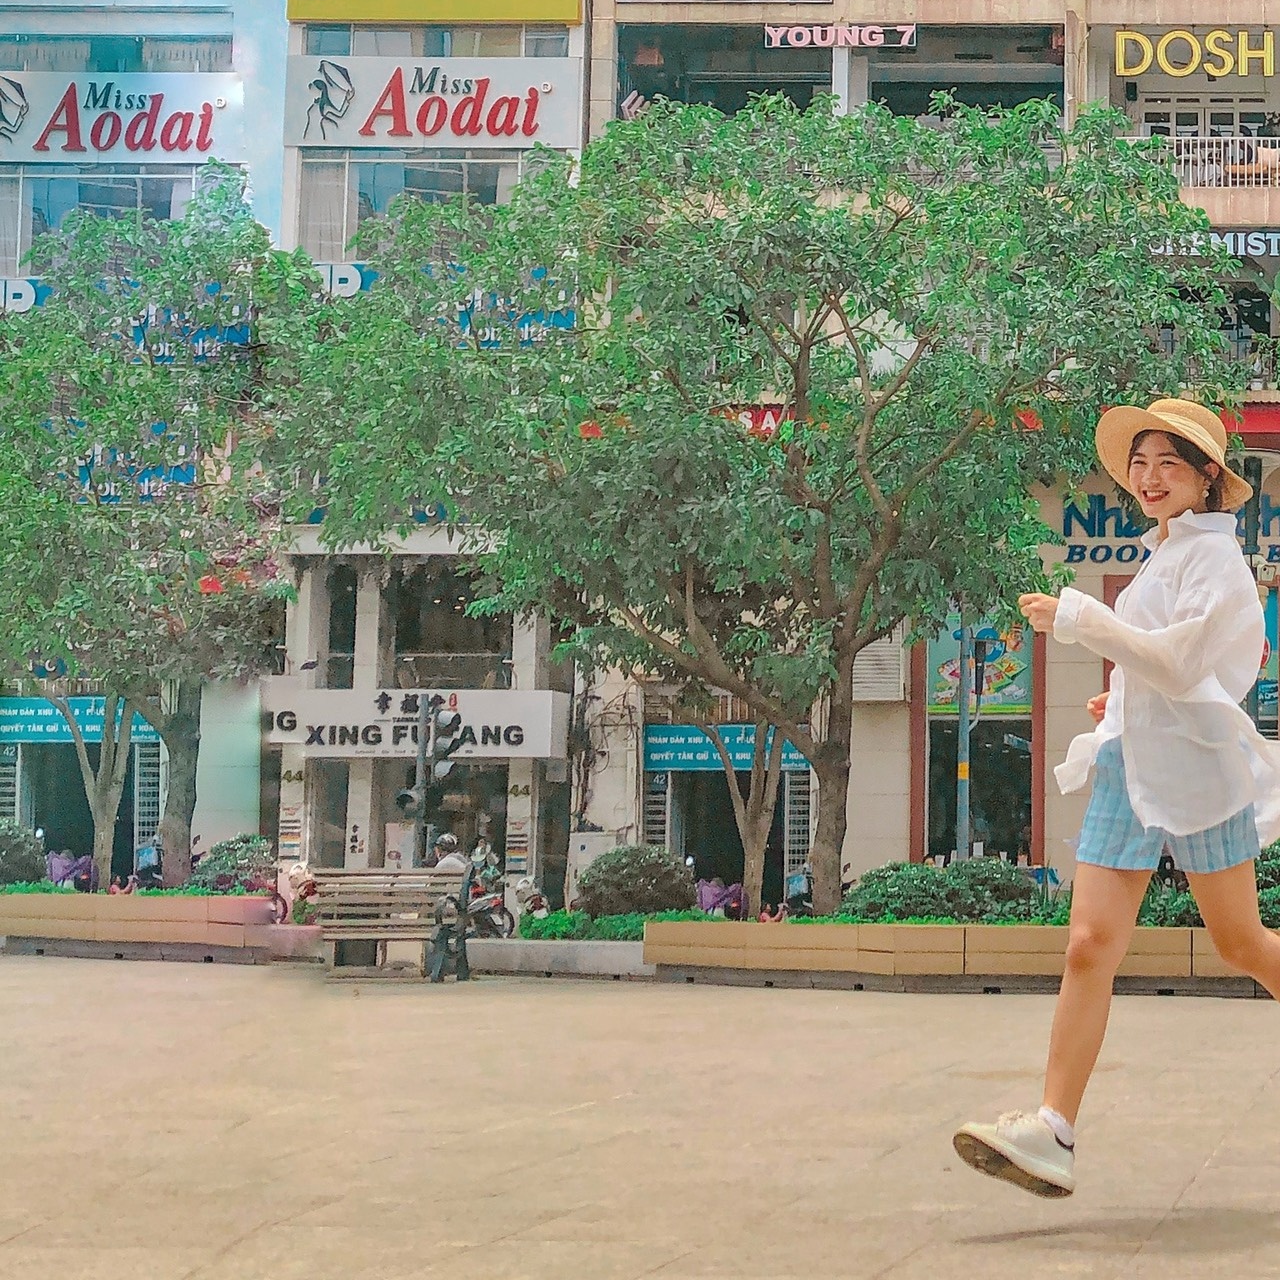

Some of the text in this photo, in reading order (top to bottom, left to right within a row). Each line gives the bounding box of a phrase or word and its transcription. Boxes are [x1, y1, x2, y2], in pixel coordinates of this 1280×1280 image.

[765, 25, 917, 47] YOUNG 7
[1115, 30, 1274, 77] DOSH
[409, 66, 474, 95] Miss
[83, 82, 149, 110] Miss
[305, 724, 382, 746] XING
[453, 724, 524, 746] ANG
[3, 746, 15, 756] 42
[653, 773, 666, 784] 42
